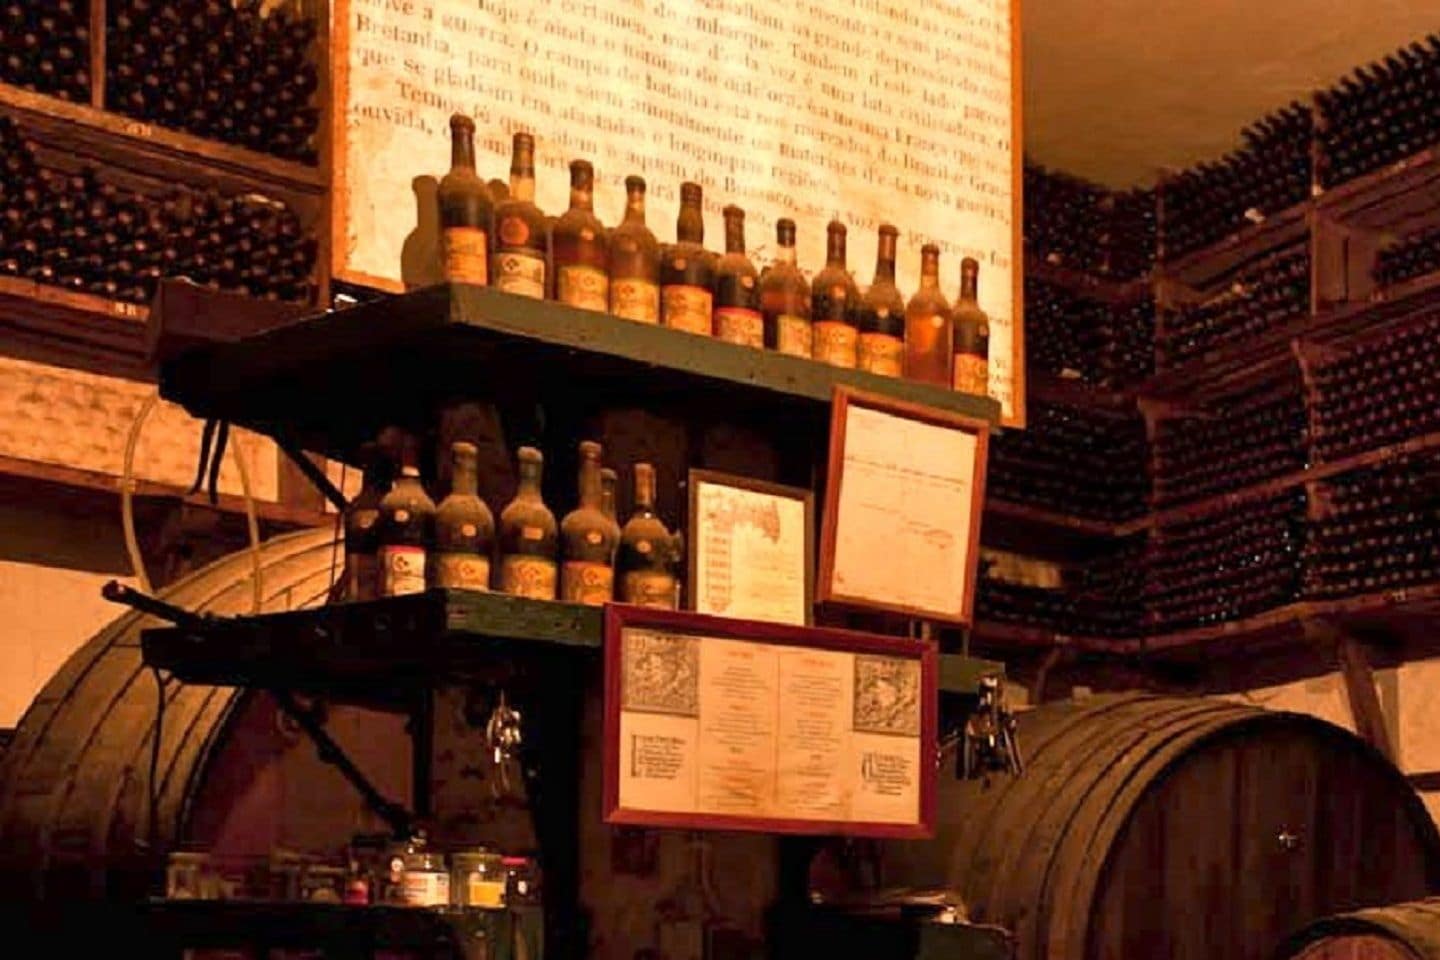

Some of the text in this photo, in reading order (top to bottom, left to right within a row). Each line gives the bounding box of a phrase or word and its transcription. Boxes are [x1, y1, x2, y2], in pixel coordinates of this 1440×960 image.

[356, 12, 454, 60] Bretanha,
[403, 56, 426, 77] se
[352, 92, 433, 137] ouvida,
